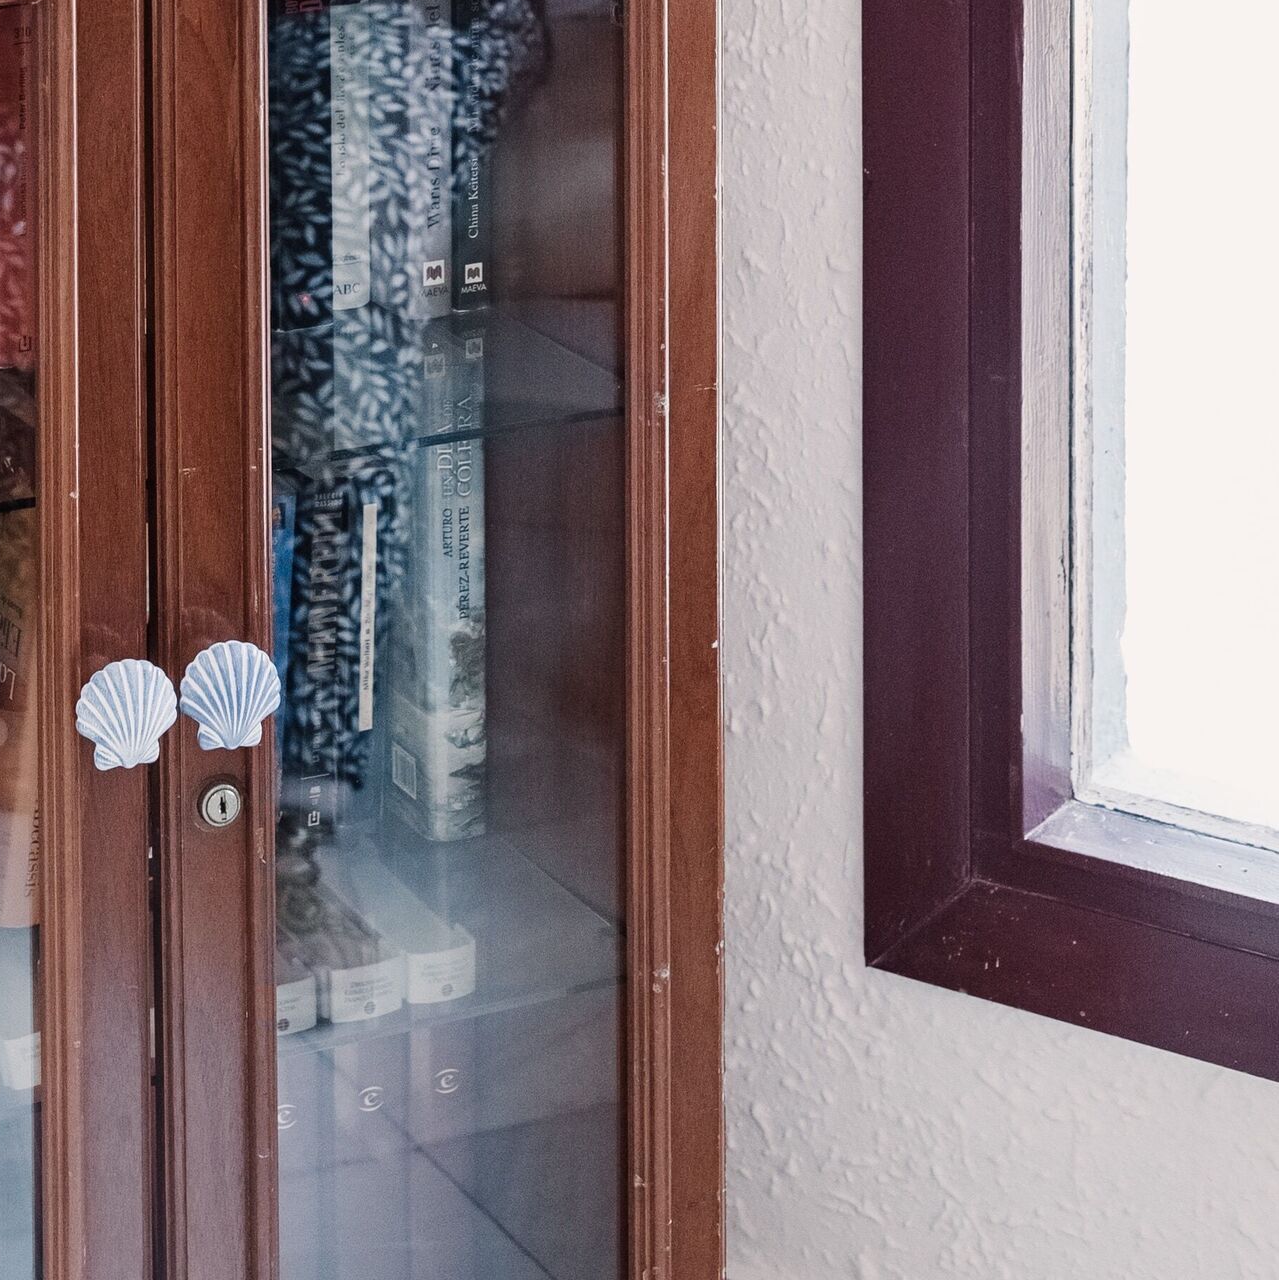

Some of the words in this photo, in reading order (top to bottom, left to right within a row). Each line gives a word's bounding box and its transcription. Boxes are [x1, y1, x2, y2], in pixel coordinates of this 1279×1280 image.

[467, 204, 479, 239] China
[334, 282, 360, 296] ABC
[461, 283, 487, 293] MAEVA
[441, 476, 453, 497] UN
[442, 508, 453, 558] ARTURO
[455, 506, 470, 620] PÉREZ-REVERTE
